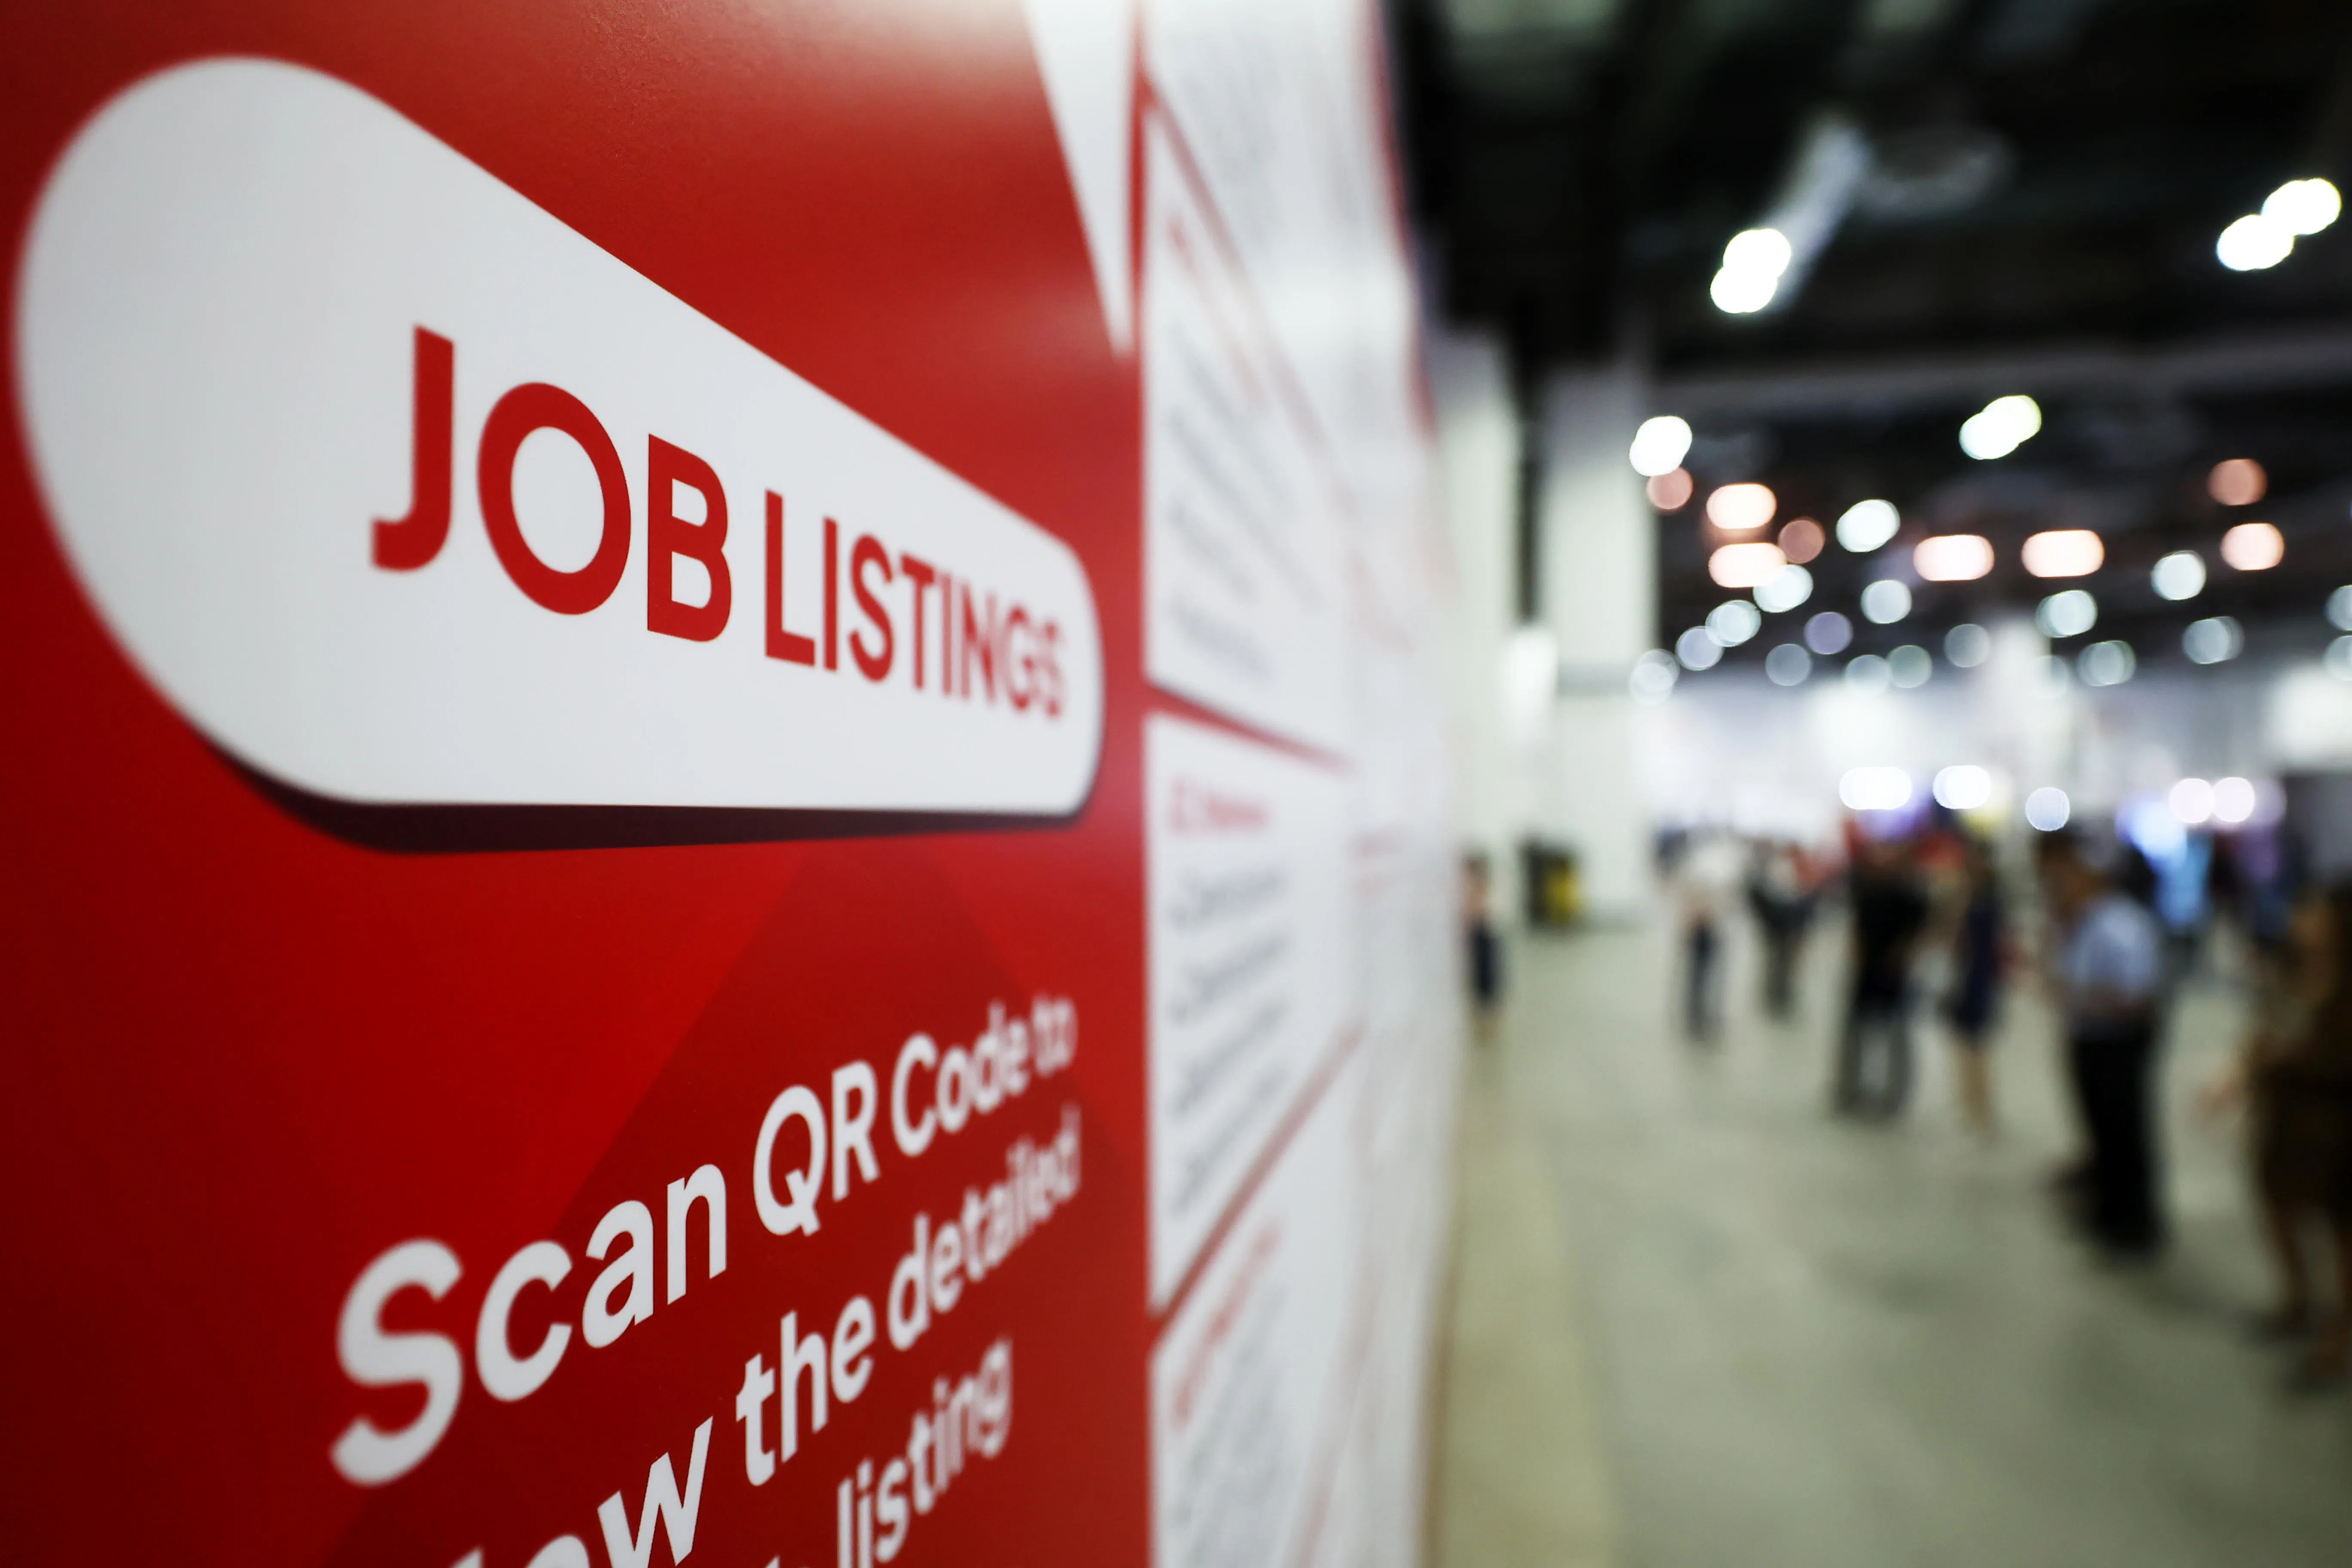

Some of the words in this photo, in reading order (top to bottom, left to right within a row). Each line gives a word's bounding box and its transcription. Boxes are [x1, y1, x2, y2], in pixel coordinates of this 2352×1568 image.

[371, 325, 732, 643] JOB
[765, 489, 1066, 719] LISTINGS
[333, 1163, 727, 1485] Scan
[753, 1060, 880, 1236] QR
[891, 999, 1029, 1157] Code
[1031, 992, 1078, 1077] to
[735, 1296, 876, 1486] the
[887, 1104, 1081, 1351] detailed
[837, 1336, 1013, 1568] listing
